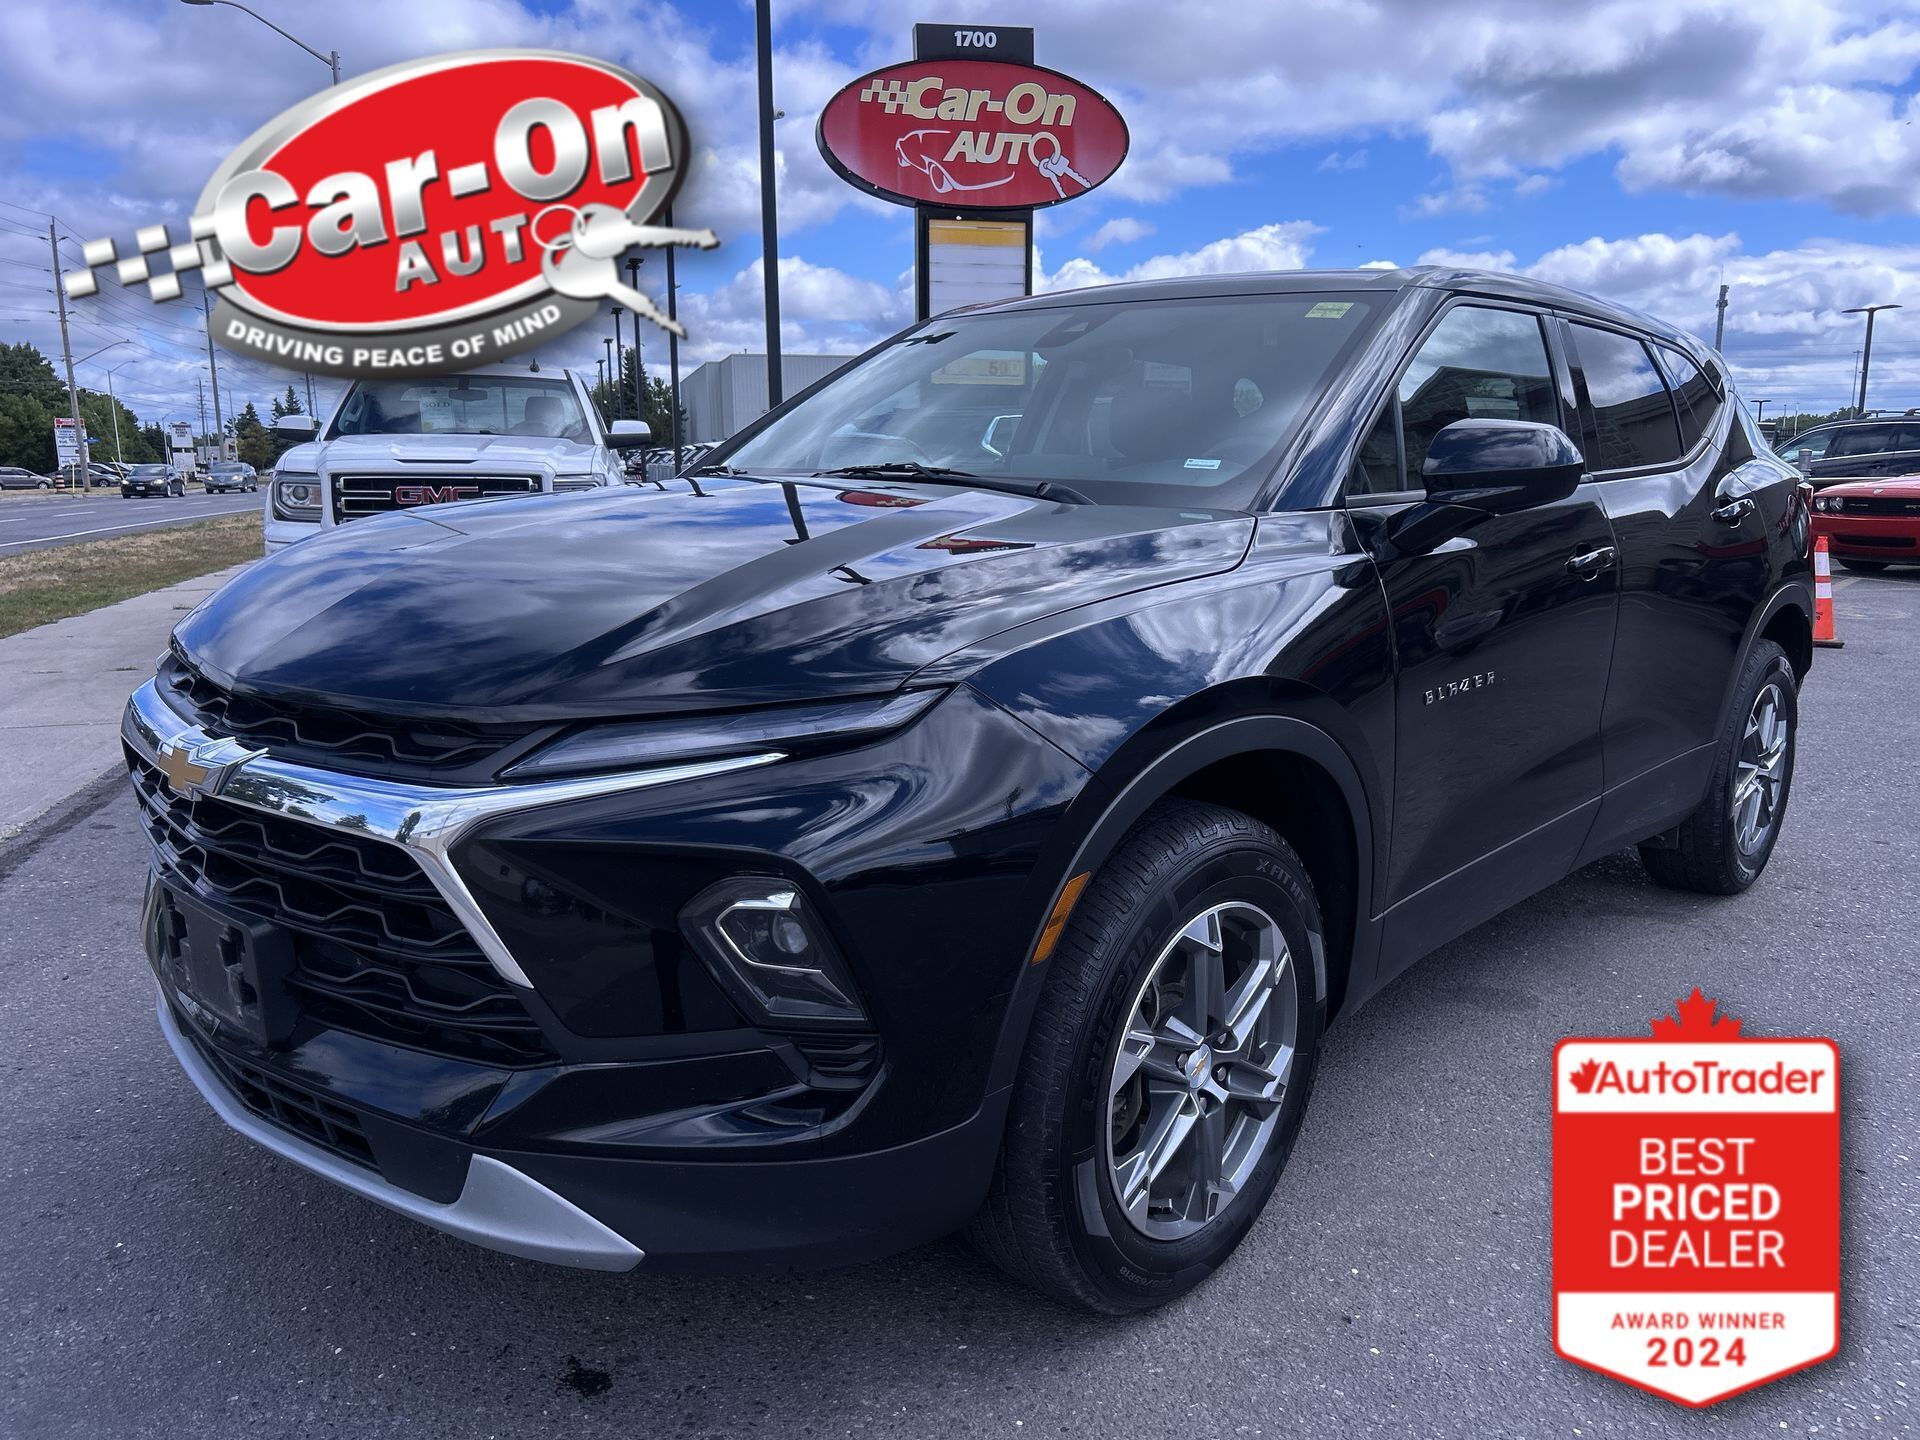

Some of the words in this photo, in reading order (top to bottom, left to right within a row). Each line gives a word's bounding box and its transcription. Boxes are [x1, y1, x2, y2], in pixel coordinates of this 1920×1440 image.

[954, 30, 998, 48] 1700
[911, 76, 1077, 126] Car-On
[942, 130, 1062, 169] AUTO
[423, 401, 451, 409] SOLD
[395, 485, 479, 505] GMC
[1424, 671, 1496, 706] BLAZER
[1270, 864, 1292, 885] FIT
